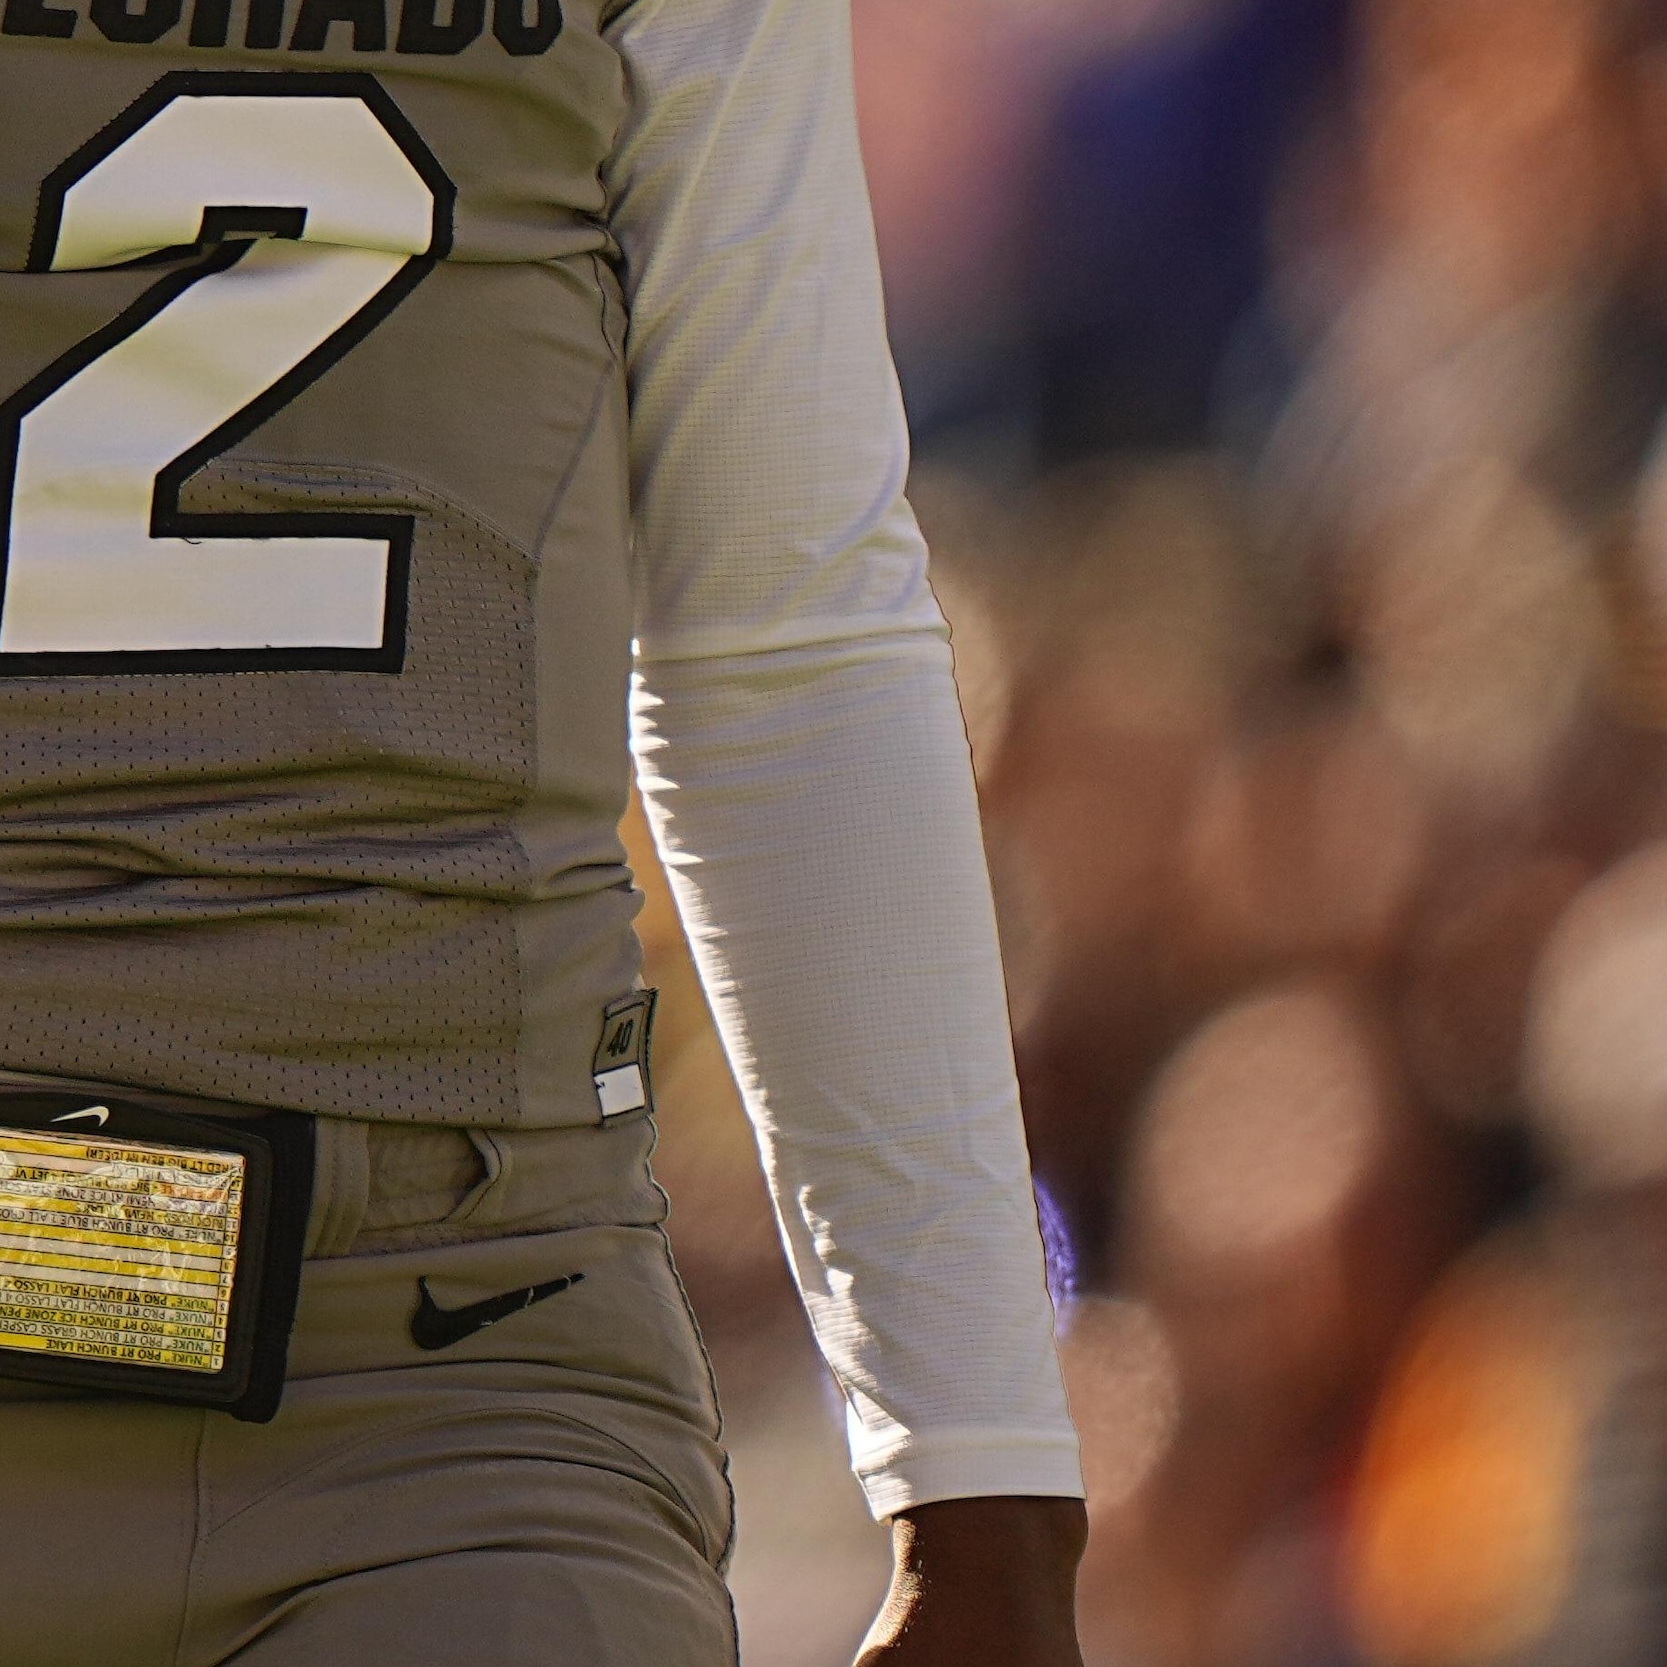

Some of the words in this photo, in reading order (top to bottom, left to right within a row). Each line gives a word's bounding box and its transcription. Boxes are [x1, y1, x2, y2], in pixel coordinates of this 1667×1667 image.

[61, 1214, 88, 1227] BLUE
[92, 1218, 131, 1232] BUNCH
[135, 1223, 148, 1234] RT
[151, 1225, 174, 1237] PRO
[13, 1279, 49, 1292] LASSO
[53, 1283, 79, 1296] FLAT
[14, 1293, 50, 1307] LASSO
[82, 1286, 122, 1301] BUNCH
[126, 1291, 139, 1303] RT
[143, 1293, 166, 1306] PRO
[53, 1297, 79, 1310] FLAT
[83, 1301, 122, 1315] BUNCH
[25, 1308, 55, 1321] ZONE
[126, 1306, 139, 1316] RT
[143, 1308, 165, 1319] PRO
[59, 1312, 76, 1324] ICE
[79, 1314, 120, 1329] BUNCH
[124, 1319, 137, 1330] RT
[41, 1324, 76, 1337] GRASS
[140, 1321, 163, 1333] PRO
[80, 1328, 119, 1342] BUNCH
[123, 1333, 136, 1344] RT
[140, 1335, 162, 1347] PRO
[45, 1339, 73, 1351] LAKE
[76, 1342, 116, 1356] BUNCH
[121, 1347, 134, 1358] RT
[137, 1349, 161, 1361] PRO
[165, 1352, 208, 1366] "NUKE"
